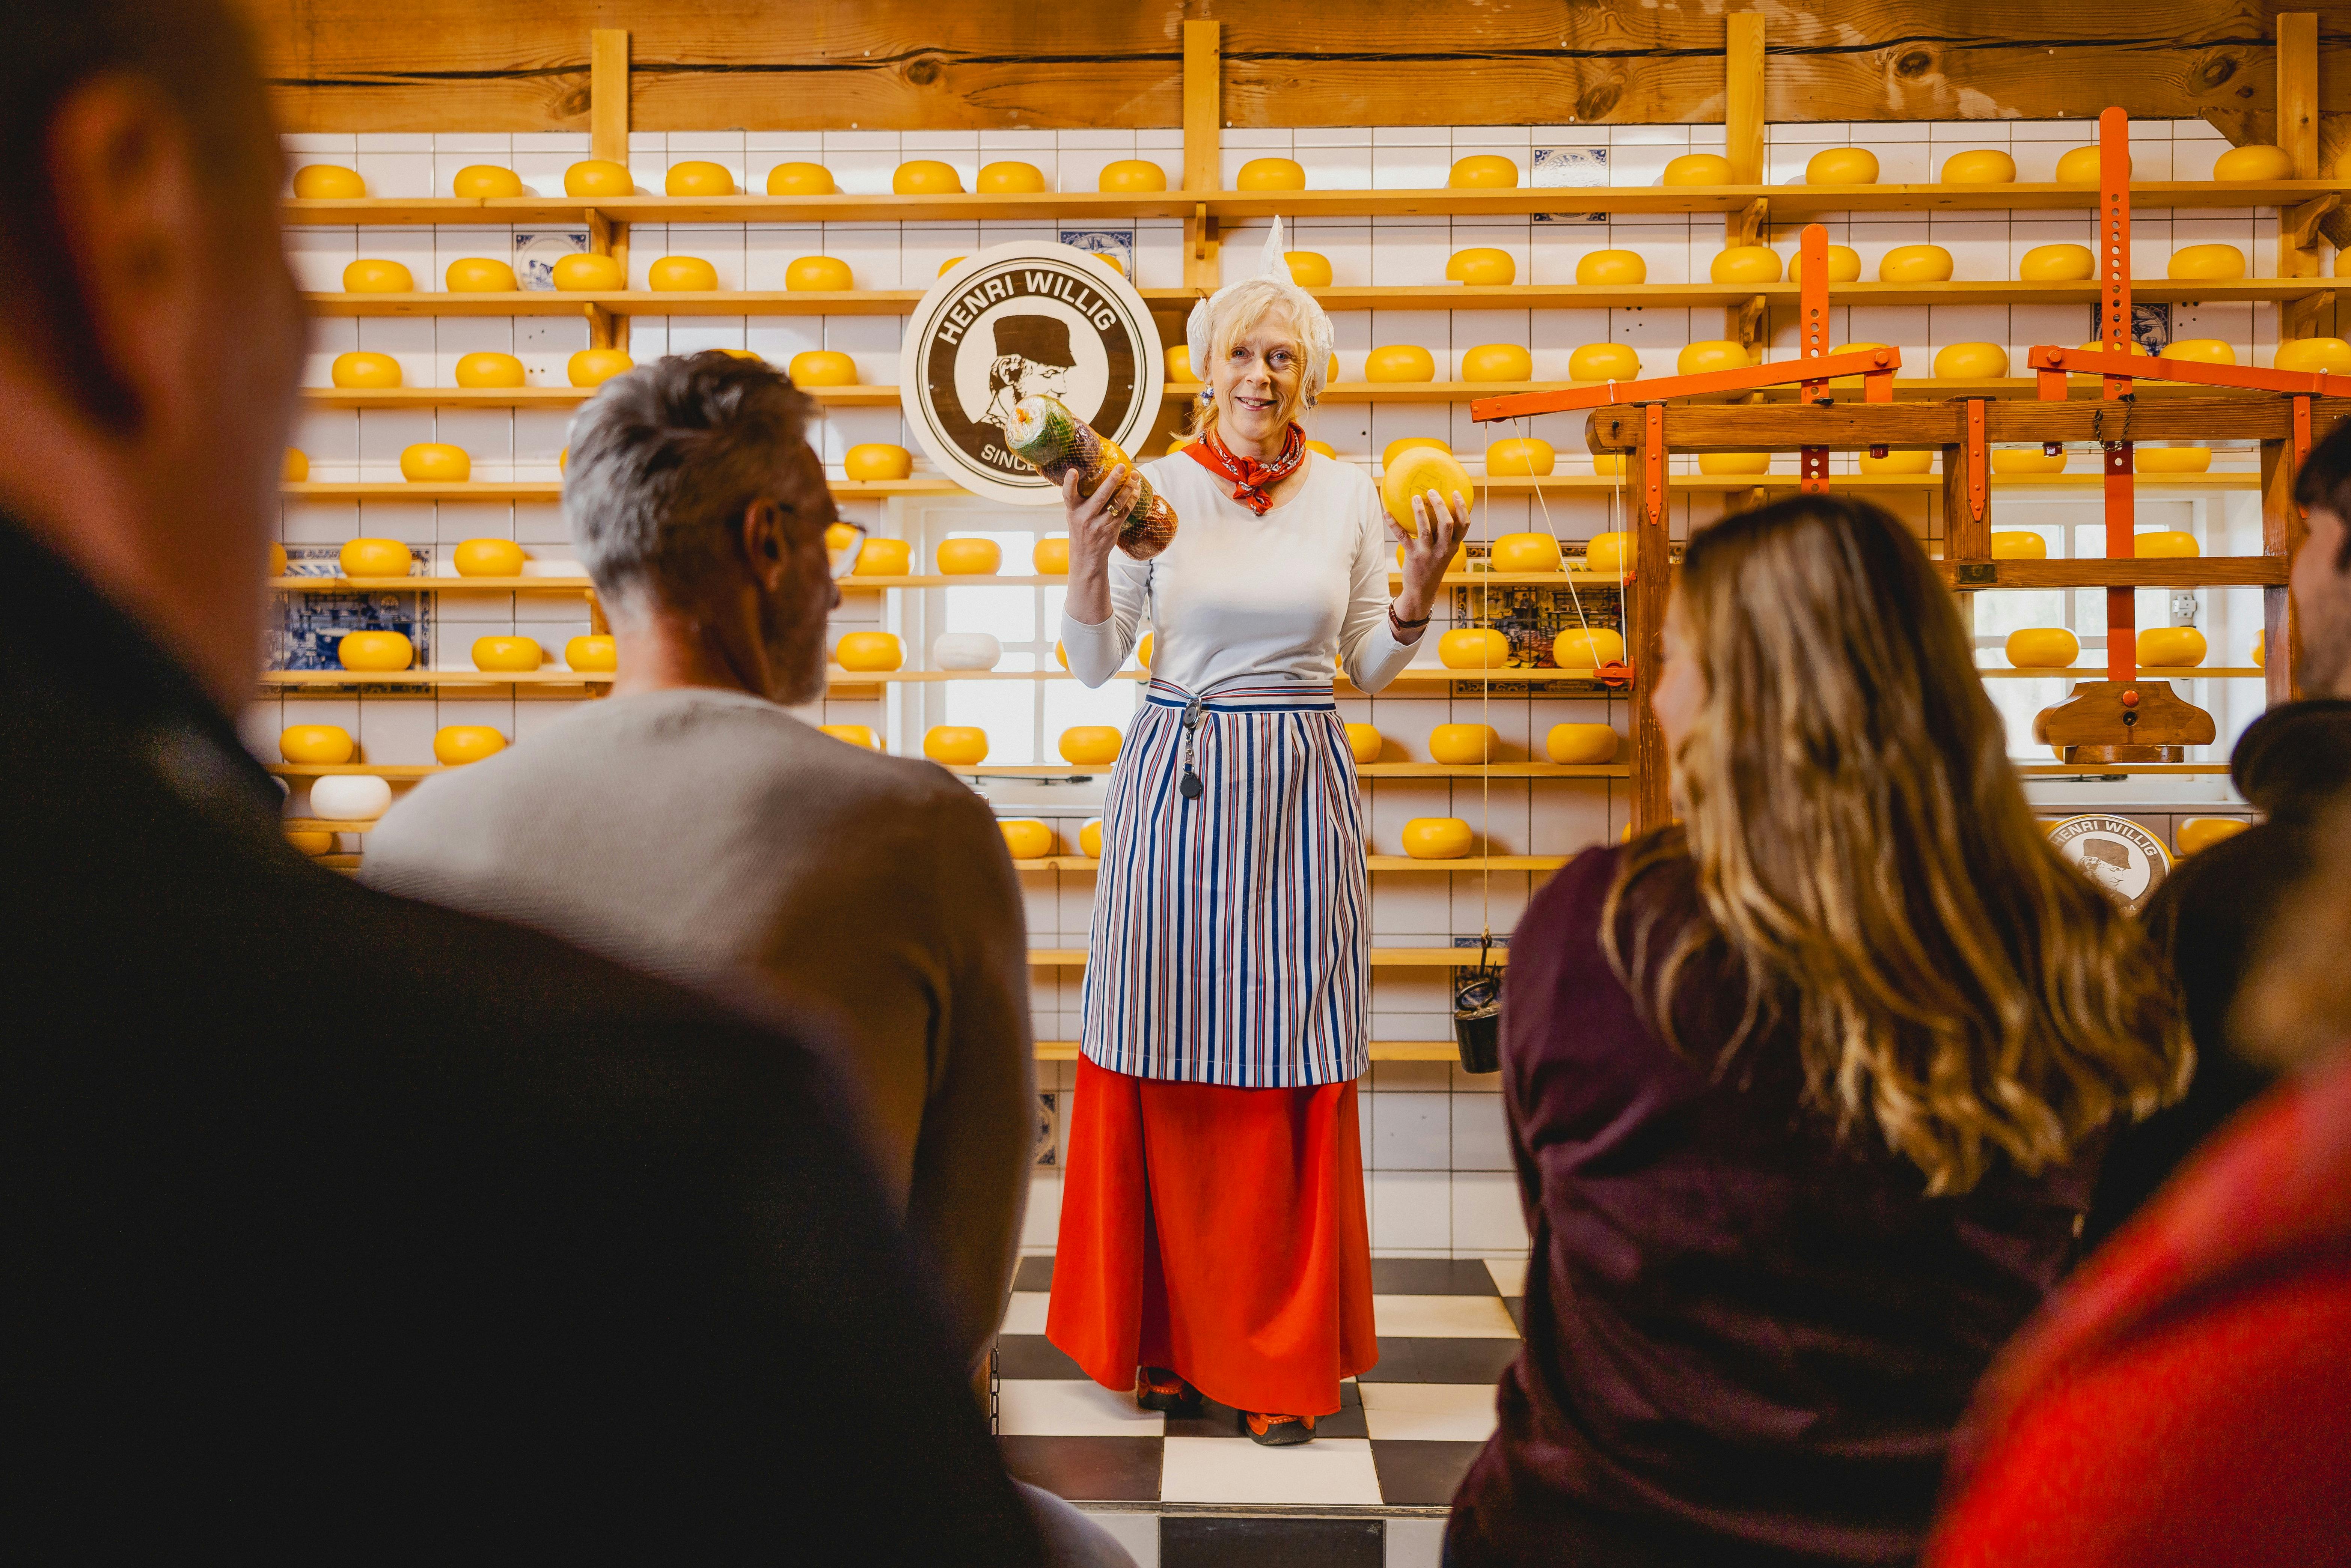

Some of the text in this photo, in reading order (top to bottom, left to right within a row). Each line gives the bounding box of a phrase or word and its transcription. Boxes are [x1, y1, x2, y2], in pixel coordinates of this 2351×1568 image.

[938, 271, 1117, 345] HENRI WILLIG
[2051, 821, 2157, 856] HENRI WILLIG
